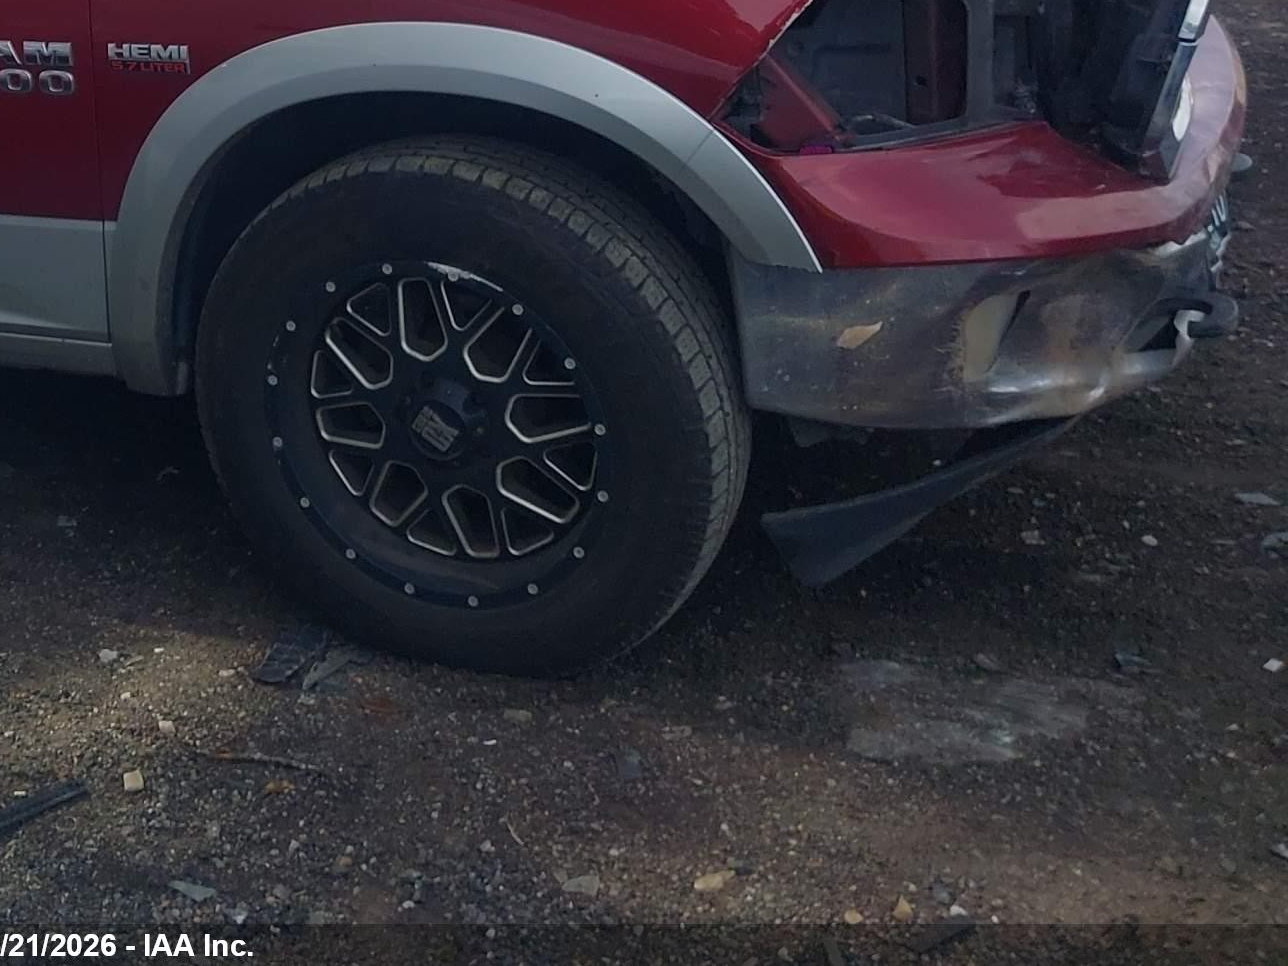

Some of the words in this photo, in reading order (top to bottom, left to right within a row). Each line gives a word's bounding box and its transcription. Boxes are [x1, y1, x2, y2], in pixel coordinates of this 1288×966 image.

[107, 42, 189, 59] HEMI
[111, 60, 136, 71] 5.7
[140, 61, 186, 73] LITER
